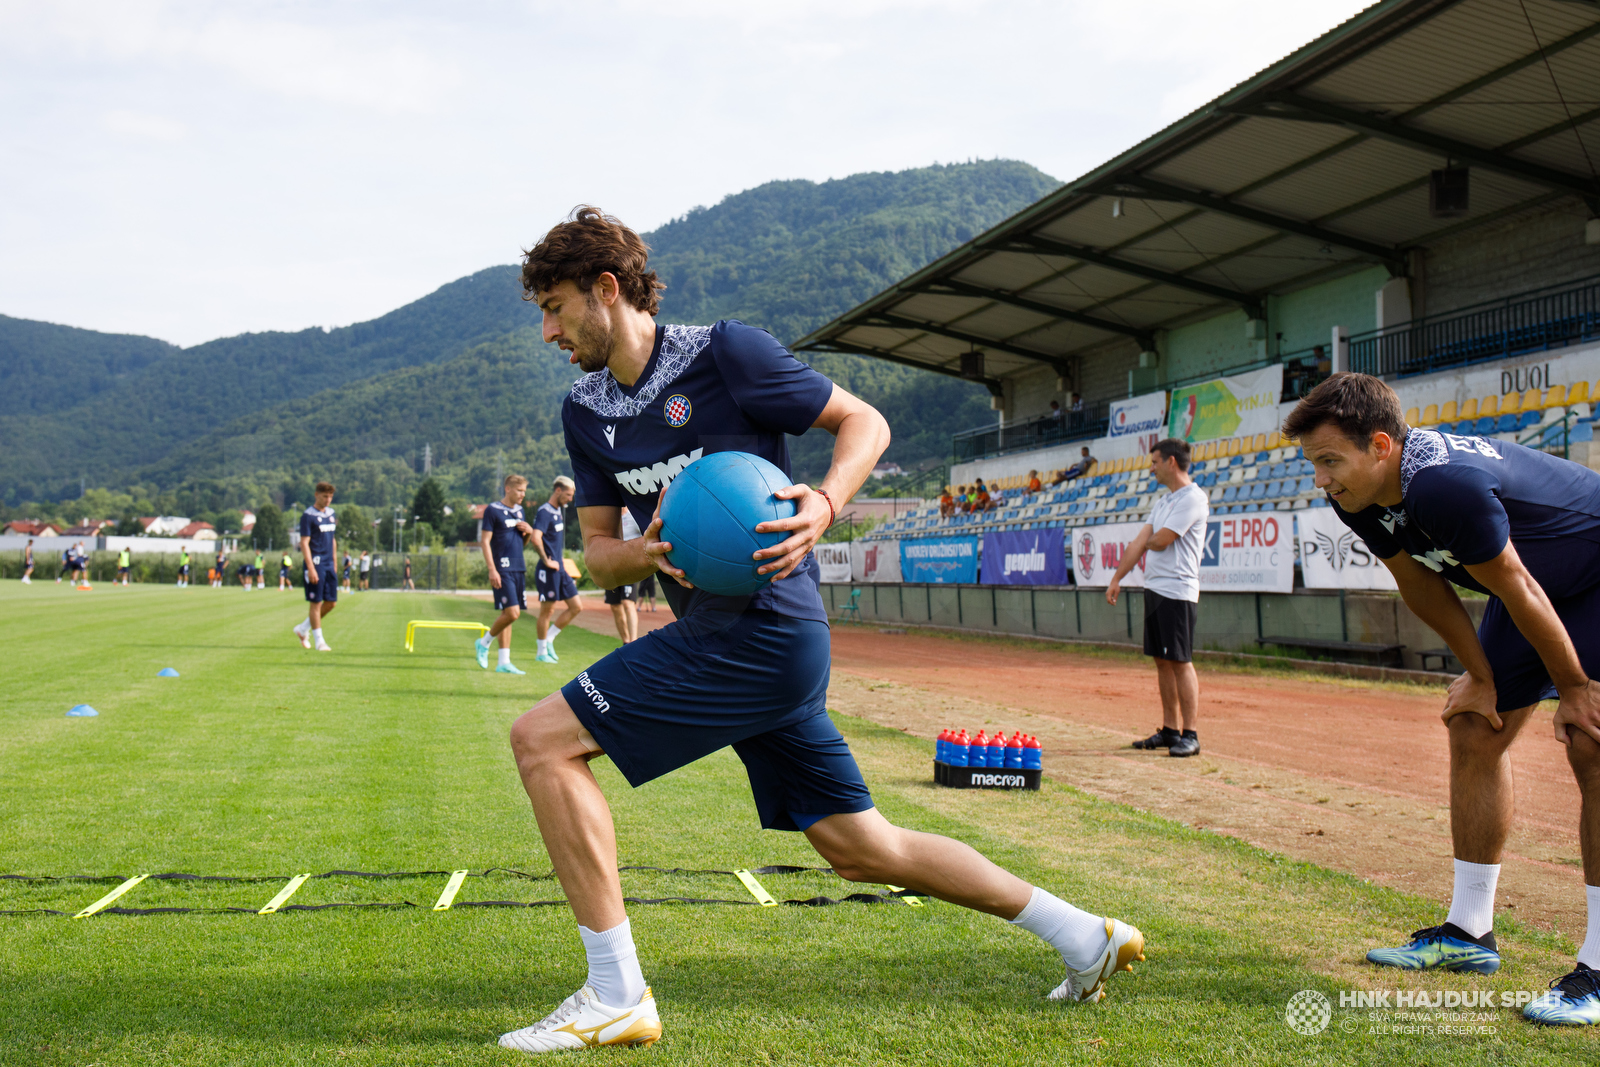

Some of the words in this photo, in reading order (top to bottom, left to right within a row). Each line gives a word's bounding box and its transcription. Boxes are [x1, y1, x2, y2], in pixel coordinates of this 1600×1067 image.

[1501, 363, 1556, 396] DUOL
[670, 416, 687, 426] SPLIT
[1223, 517, 1279, 548] ELPRO
[1003, 538, 1046, 575] geoplin
[577, 671, 611, 714] macron
[971, 773, 1026, 787] macron
